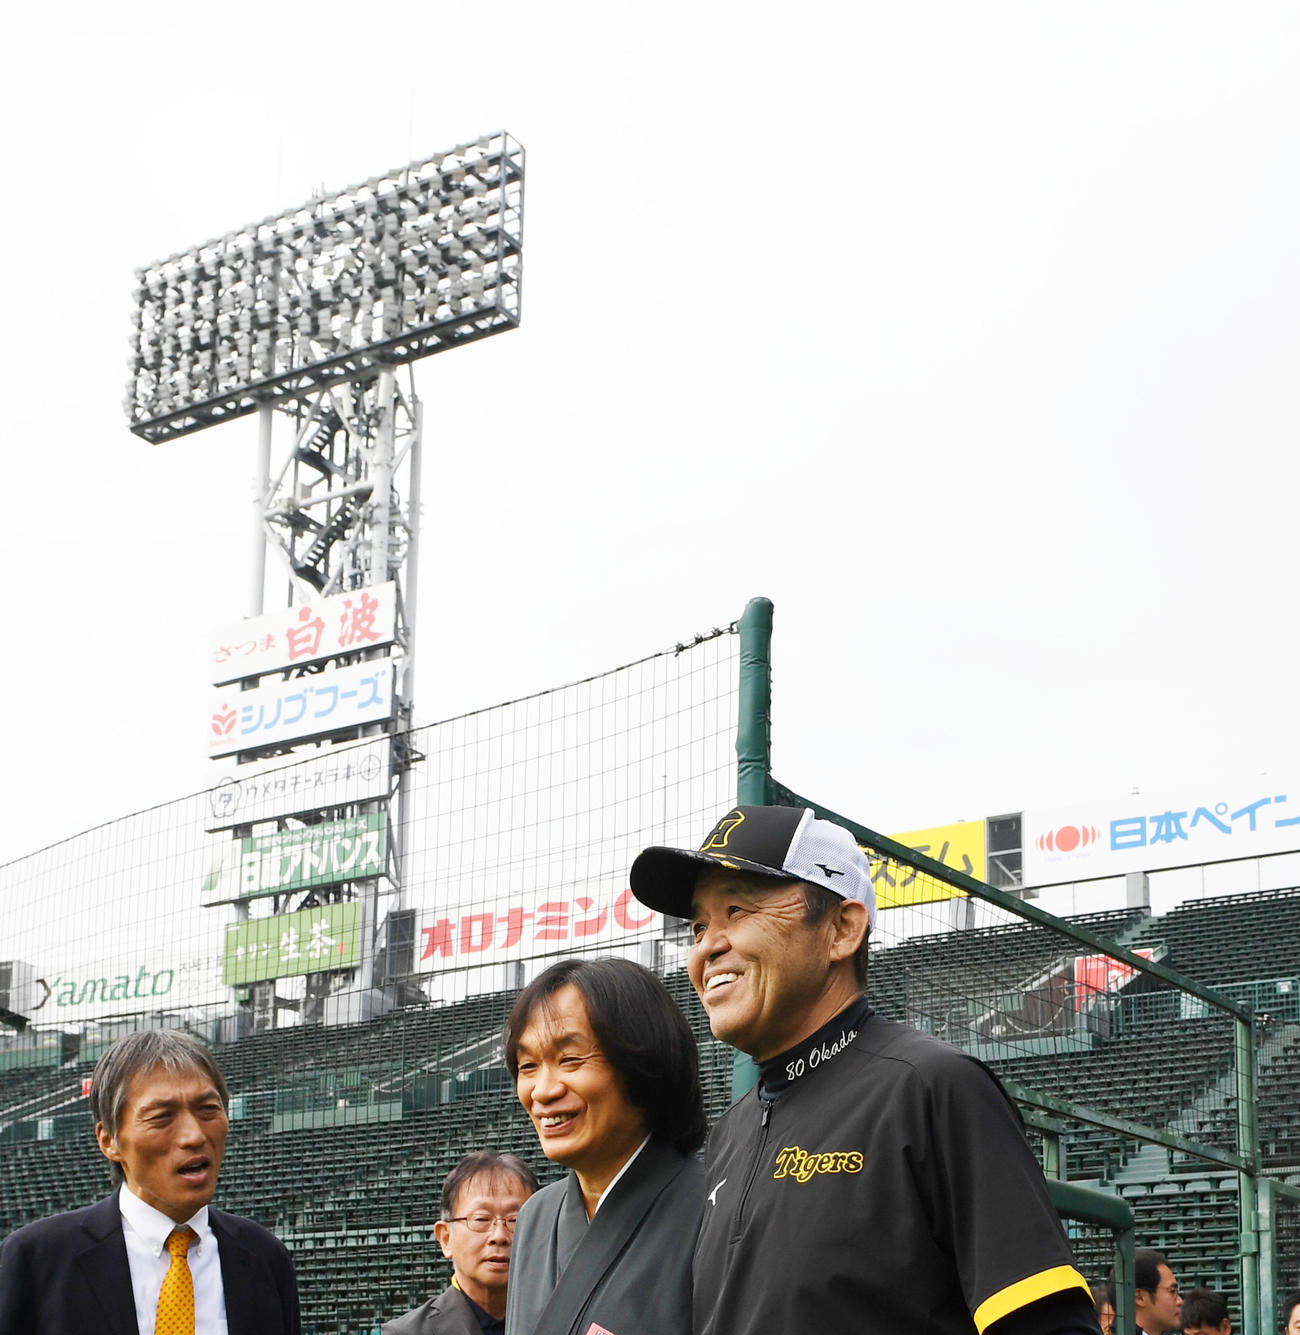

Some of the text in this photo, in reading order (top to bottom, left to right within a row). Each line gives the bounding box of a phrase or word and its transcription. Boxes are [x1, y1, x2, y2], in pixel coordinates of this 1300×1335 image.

[241, 670, 387, 736] シノブフーズ
[420, 888, 657, 961] オロナミンC
[785, 1028, 858, 1081] 80 Okada
[773, 1146, 864, 1183] Tigers
